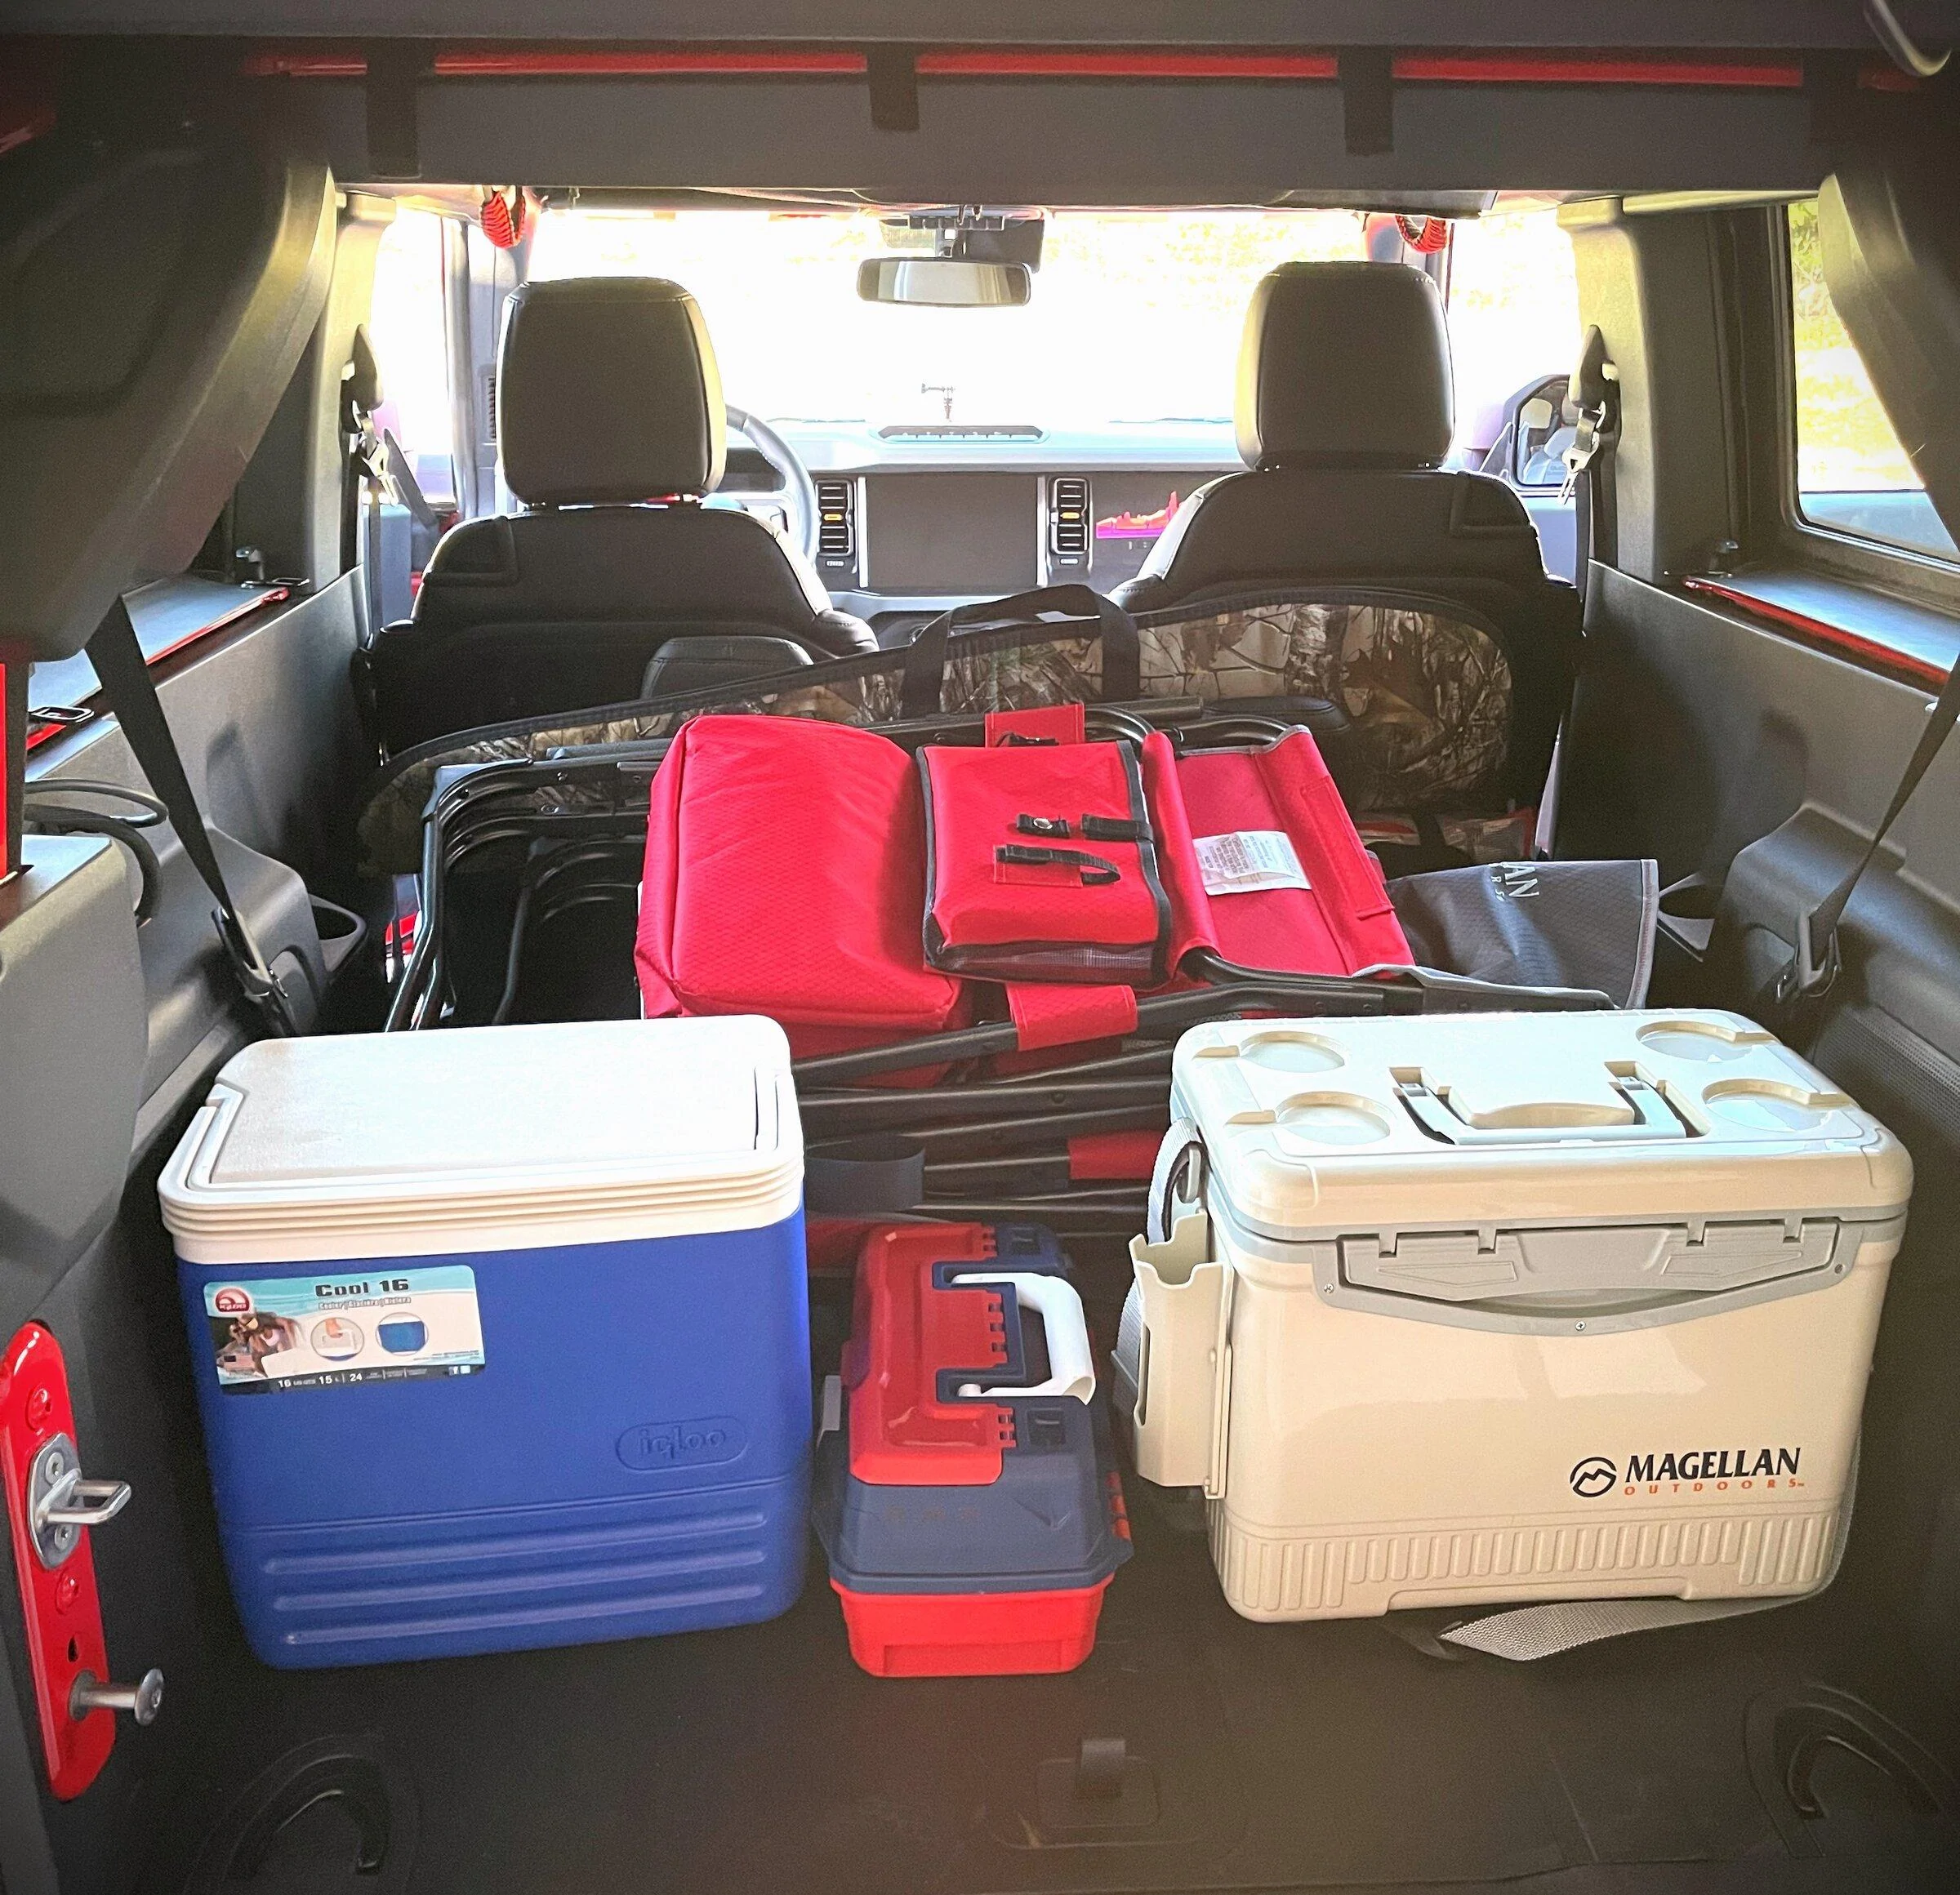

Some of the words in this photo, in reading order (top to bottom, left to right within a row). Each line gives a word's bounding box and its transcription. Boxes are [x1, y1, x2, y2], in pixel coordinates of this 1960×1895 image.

[315, 1281, 369, 1297] Cool
[379, 1279, 409, 1292] 16
[278, 1378, 292, 1388] 16
[318, 1375, 333, 1385] 15
[350, 1372, 363, 1382] 24
[1624, 1447, 1802, 1484] MAGELLAN
[1624, 1478, 1797, 1497] OUTDOORS
